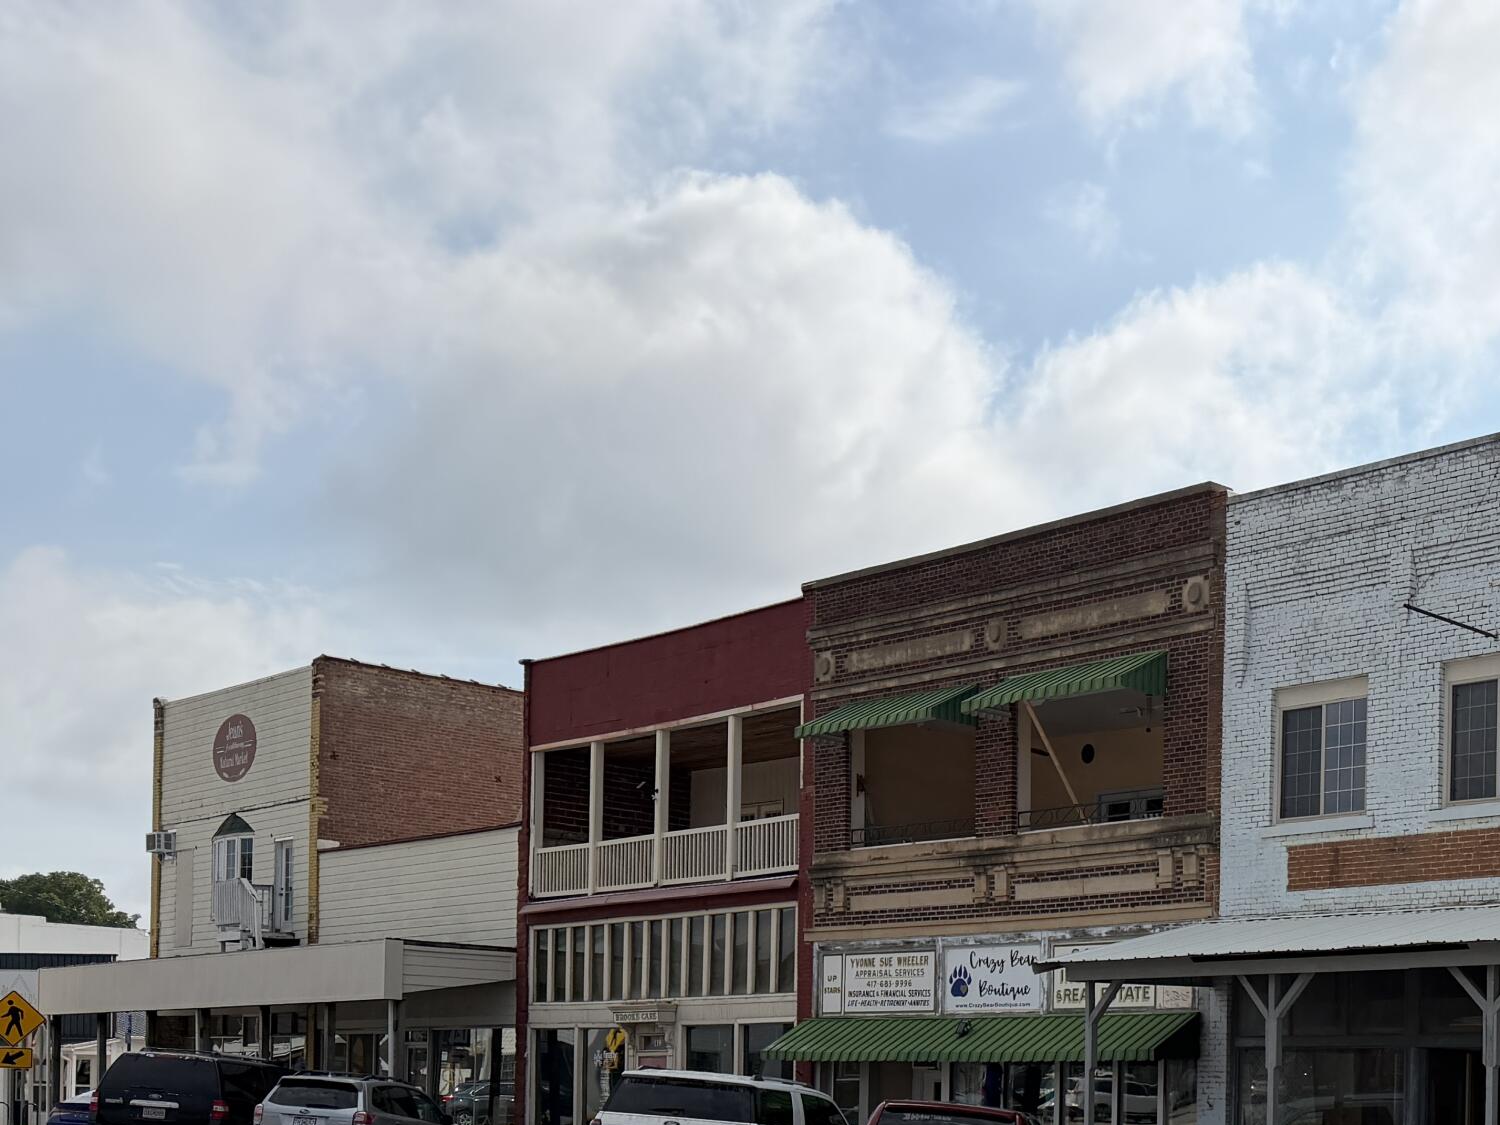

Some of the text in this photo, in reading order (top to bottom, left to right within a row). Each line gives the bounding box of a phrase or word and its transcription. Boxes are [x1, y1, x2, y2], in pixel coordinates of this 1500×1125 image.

[850, 955, 929, 968] YVONNE SUE WHEELER
[970, 950, 1005, 974] Crazy
[855, 968, 925, 977] APPRAISAL SERVICES
[848, 990, 876, 998] INSURANCE
[881, 990, 906, 998] FINANCIAL
[908, 989, 931, 998] SERVICES
[979, 979, 1031, 1000] Boutique
[1063, 988, 1086, 1002] REA
